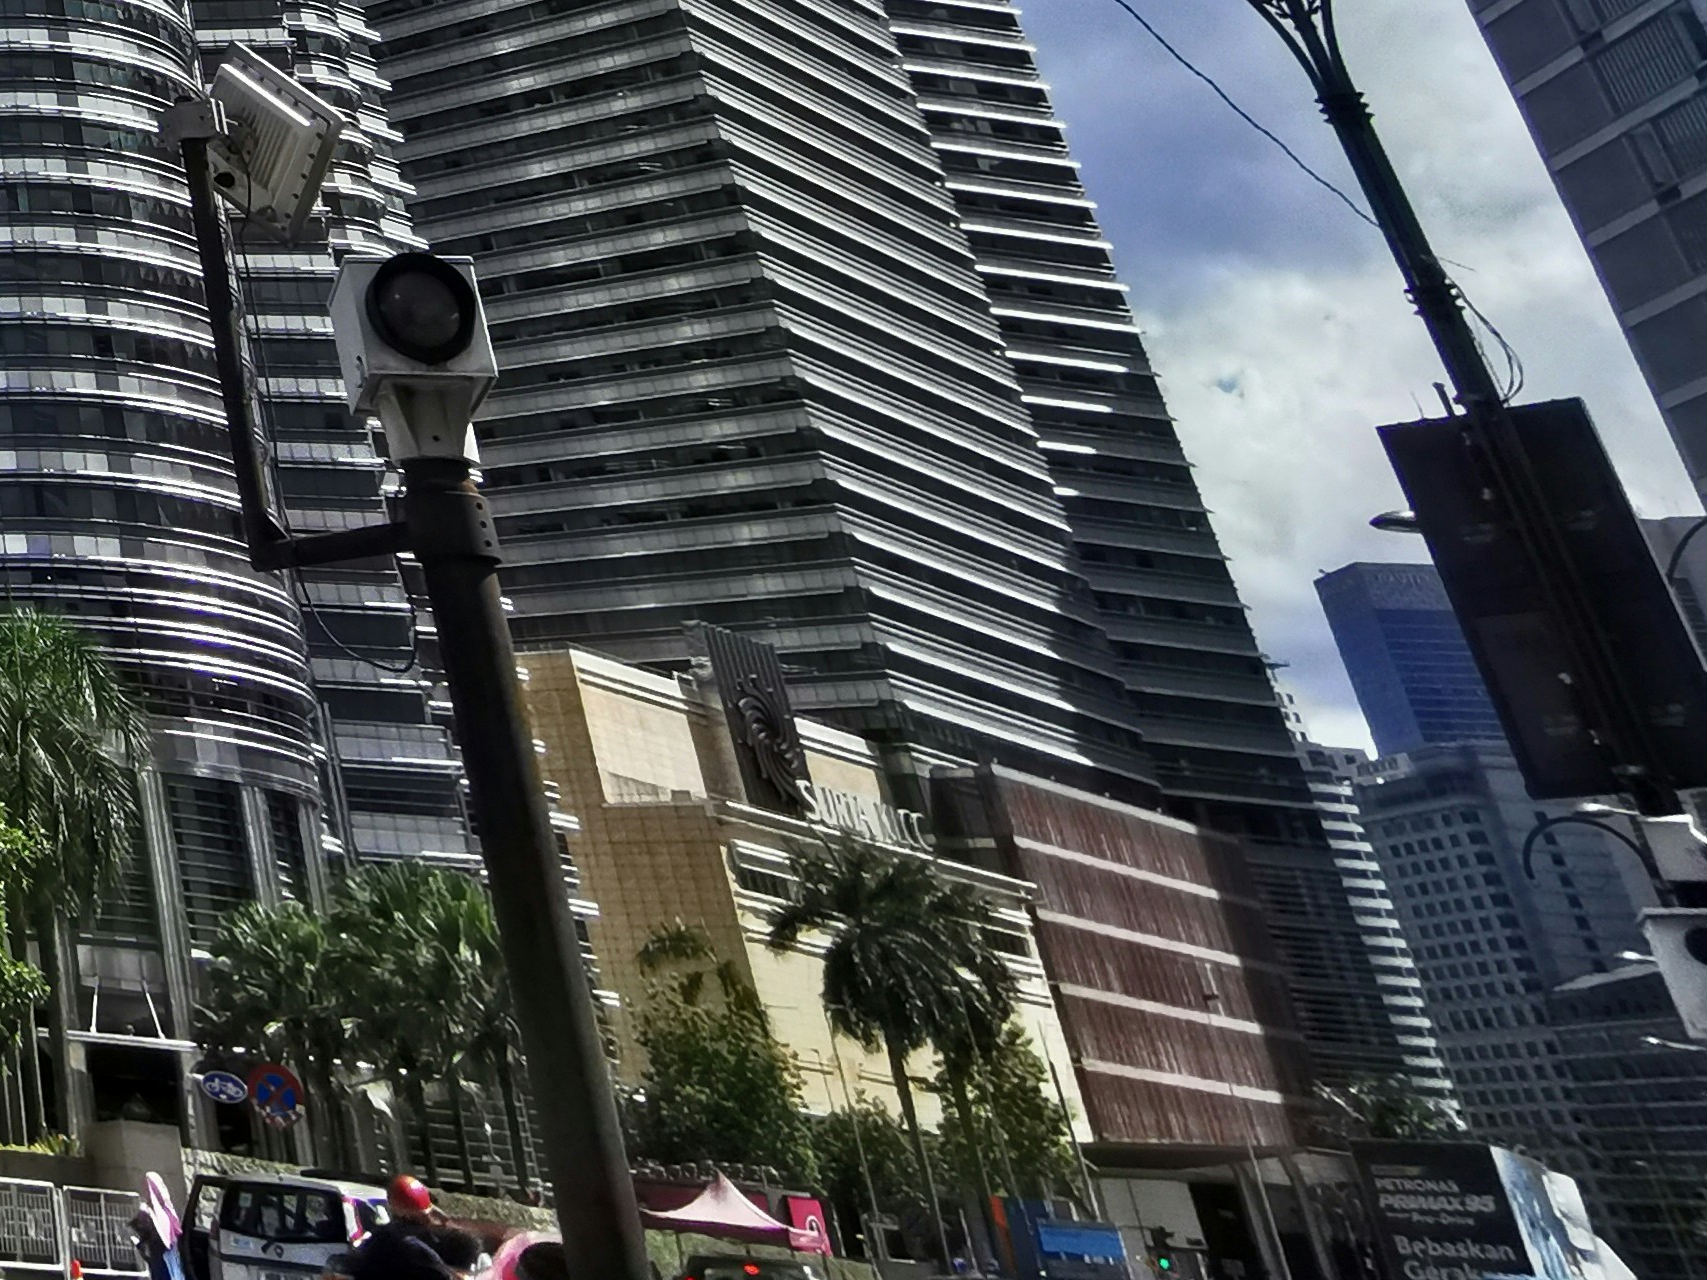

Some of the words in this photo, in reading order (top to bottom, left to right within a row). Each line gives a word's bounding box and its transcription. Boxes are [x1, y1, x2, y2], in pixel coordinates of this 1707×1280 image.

[1373, 1177, 1460, 1193] PETRONAS
[1378, 1193, 1466, 1212] PRIMAX
[1464, 1194, 1496, 1213] 95
[1393, 1234, 1517, 1261] Bebaskan
